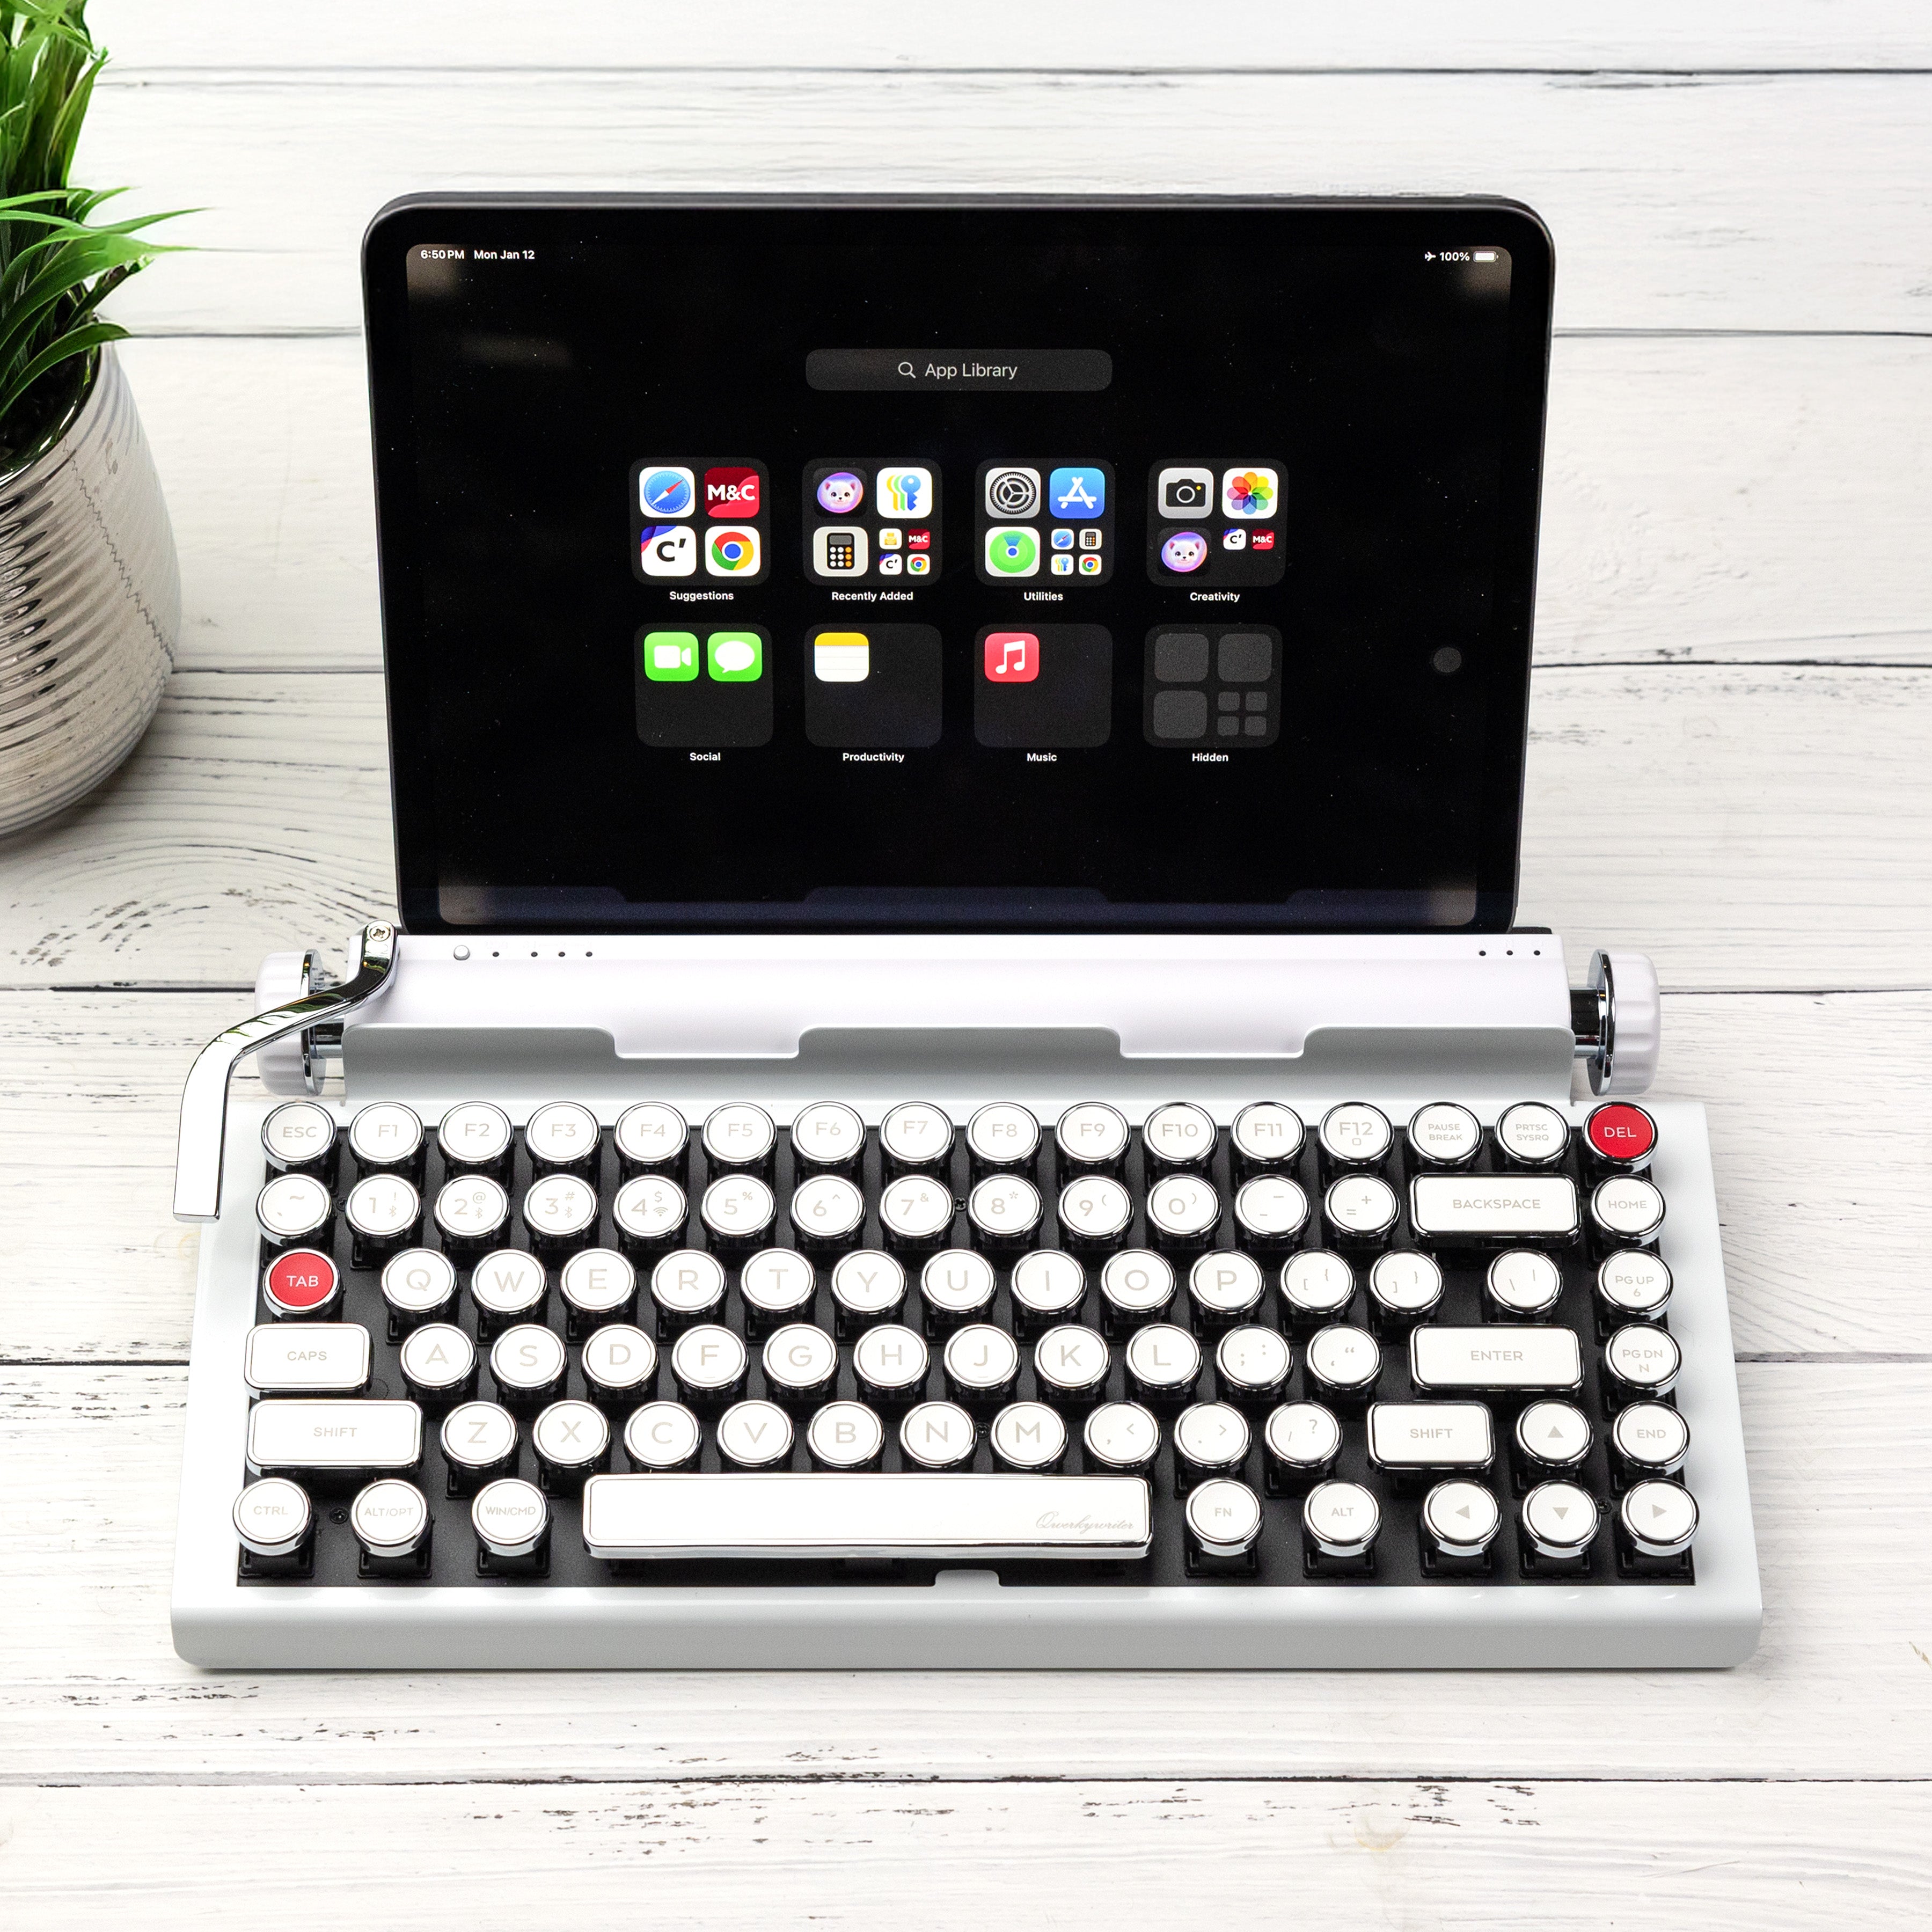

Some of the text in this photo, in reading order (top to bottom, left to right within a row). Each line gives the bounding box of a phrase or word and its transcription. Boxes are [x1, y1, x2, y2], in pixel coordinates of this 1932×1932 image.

[474, 250, 535, 260] Mon Jan 12
[1439, 252, 1470, 261] 100%
[925, 363, 1018, 380] App Library
[707, 484, 756, 501] M&C
[909, 535, 928, 543] M&C
[669, 590, 734, 602] Suggestions
[831, 591, 913, 602] Recently Added
[1023, 591, 1064, 601] Utilities
[1189, 591, 1240, 603] Creativity
[690, 752, 721, 761] Social
[843, 752, 905, 763] Productivity
[1027, 752, 1057, 762] Music
[1192, 752, 1229, 762] Hidden
[282, 1126, 317, 1138] ESC
[378, 1124, 398, 1138] F1
[465, 1123, 490, 1137] F2
[551, 1123, 576, 1137] F3
[640, 1123, 665, 1137] F4
[728, 1123, 753, 1137] F5
[816, 1122, 841, 1136] F6
[903, 1120, 928, 1135] F7
[992, 1123, 1018, 1138] F8
[1080, 1123, 1106, 1137] F9
[1162, 1123, 1198, 1137] F10
[1254, 1123, 1283, 1137] F11
[1339, 1121, 1373, 1136] F12
[1428, 1123, 1460, 1131] PAUSE
[1515, 1123, 1548, 1131] PRTSC
[1604, 1126, 1637, 1138] DEL
[1516, 1133, 1549, 1141] SYSRQ
[369, 1197, 377, 1214] 1
[454, 1198, 468, 1216] 2
[544, 1197, 559, 1215] 3
[631, 1198, 648, 1216] 4
[723, 1198, 738, 1216] 5
[813, 1199, 827, 1217] 6
[901, 1199, 914, 1216] 7
[991, 1197, 1006, 1215] 8
[1079, 1199, 1094, 1217] 9
[1453, 1199, 1541, 1209] BACKSPACE
[1608, 1199, 1647, 1209] HOME
[286, 1275, 319, 1287] TAB
[406, 1268, 431, 1292] Q
[493, 1271, 525, 1292] W
[588, 1268, 608, 1290] E
[678, 1269, 699, 1291] R
[769, 1268, 789, 1290] T
[857, 1271, 879, 1293] Y
[947, 1270, 968, 1291] U
[1045, 1270, 1050, 1292] I
[1124, 1269, 1150, 1291] O
[1217, 1270, 1237, 1291] P
[1615, 1275, 1655, 1285] PG UP
[1633, 1288, 1641, 1297] 6
[287, 1351, 327, 1362] CAPS
[425, 1343, 449, 1365] A
[519, 1344, 538, 1367] S
[609, 1343, 631, 1365] D
[700, 1344, 720, 1366] F
[788, 1345, 813, 1367] G
[881, 1344, 902, 1366] H
[973, 1345, 988, 1367] J
[1060, 1344, 1081, 1367] K
[1153, 1344, 1172, 1366] L
[1470, 1350, 1524, 1361] ENTER
[1622, 1349, 1663, 1359] PG DN
[1638, 1364, 1650, 1373] N
[313, 1426, 358, 1437] SHIFT
[467, 1421, 488, 1444] Z
[560, 1421, 582, 1443] X
[651, 1422, 673, 1444] C
[743, 1422, 768, 1444] V
[835, 1422, 857, 1444] B
[926, 1421, 948, 1443] N
[1015, 1421, 1041, 1443] M
[1410, 1428, 1453, 1439] SHIFT
[1636, 1429, 1666, 1439] END
[253, 1505, 288, 1516] CTRL
[364, 1507, 414, 1517] ALT/OPT
[485, 1506, 536, 1516] WIN/CMD
[1214, 1507, 1232, 1517] FN
[1331, 1507, 1354, 1517] ALT
[1035, 1511, 1134, 1535] Qwerkywriter
